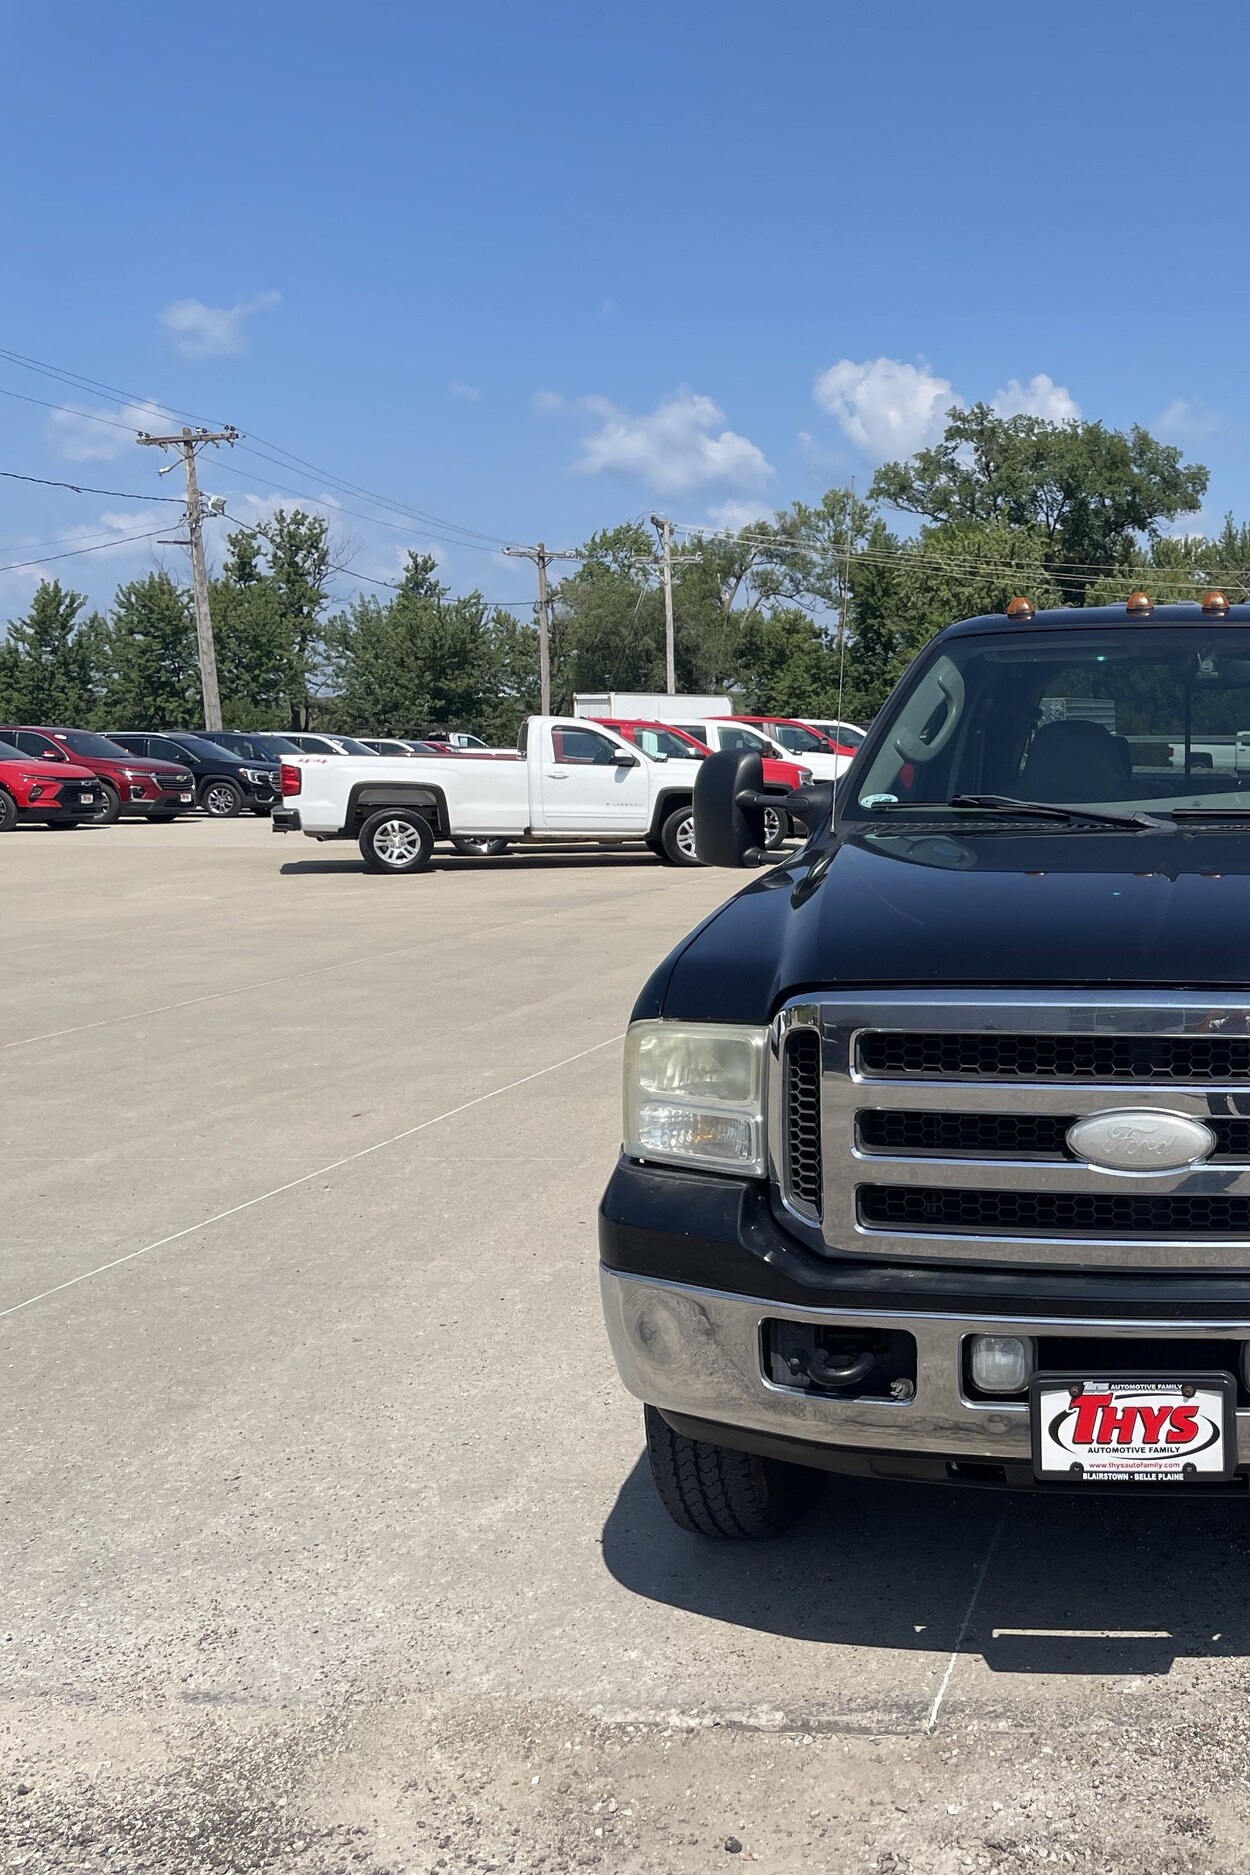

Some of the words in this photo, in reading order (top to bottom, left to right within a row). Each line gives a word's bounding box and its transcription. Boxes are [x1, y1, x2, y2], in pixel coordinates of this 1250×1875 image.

[1102, 1126, 1179, 1155] Ford
[1069, 1393, 1200, 1444] THYS
[1087, 1446, 1147, 1454] AUTOMOTIVE
[1148, 1446, 1181, 1454] FAMILY
[1088, 1462, 1181, 1470] www.thysautofamily.com
[1082, 1472, 1129, 1480] BLAIRSTOWN
[1134, 1472, 1157, 1480] BELLE
[1157, 1473, 1184, 1481] PLAINE
